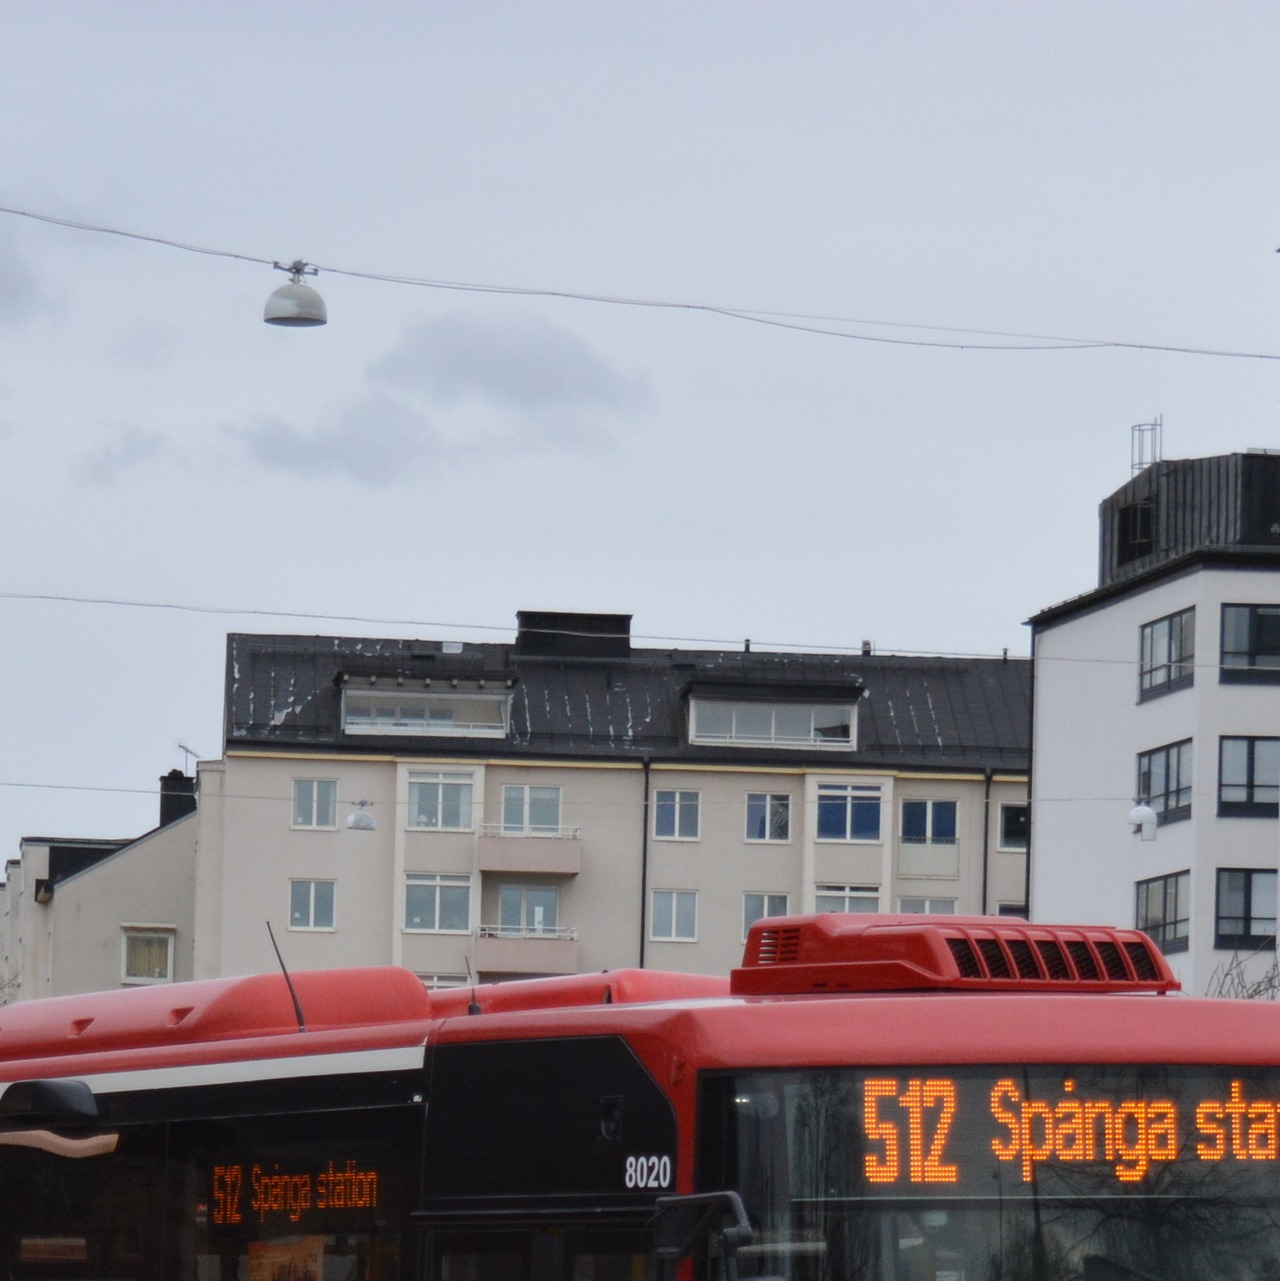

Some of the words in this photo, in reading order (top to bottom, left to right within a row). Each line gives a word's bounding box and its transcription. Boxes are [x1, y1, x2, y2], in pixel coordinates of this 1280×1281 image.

[864, 1078, 957, 1183] 512
[991, 1078, 1177, 1181] Spånga
[212, 1165, 243, 1224] 512
[251, 1162, 312, 1223] Spånga
[317, 1160, 379, 1209] station
[625, 1155, 671, 1188] 8020
